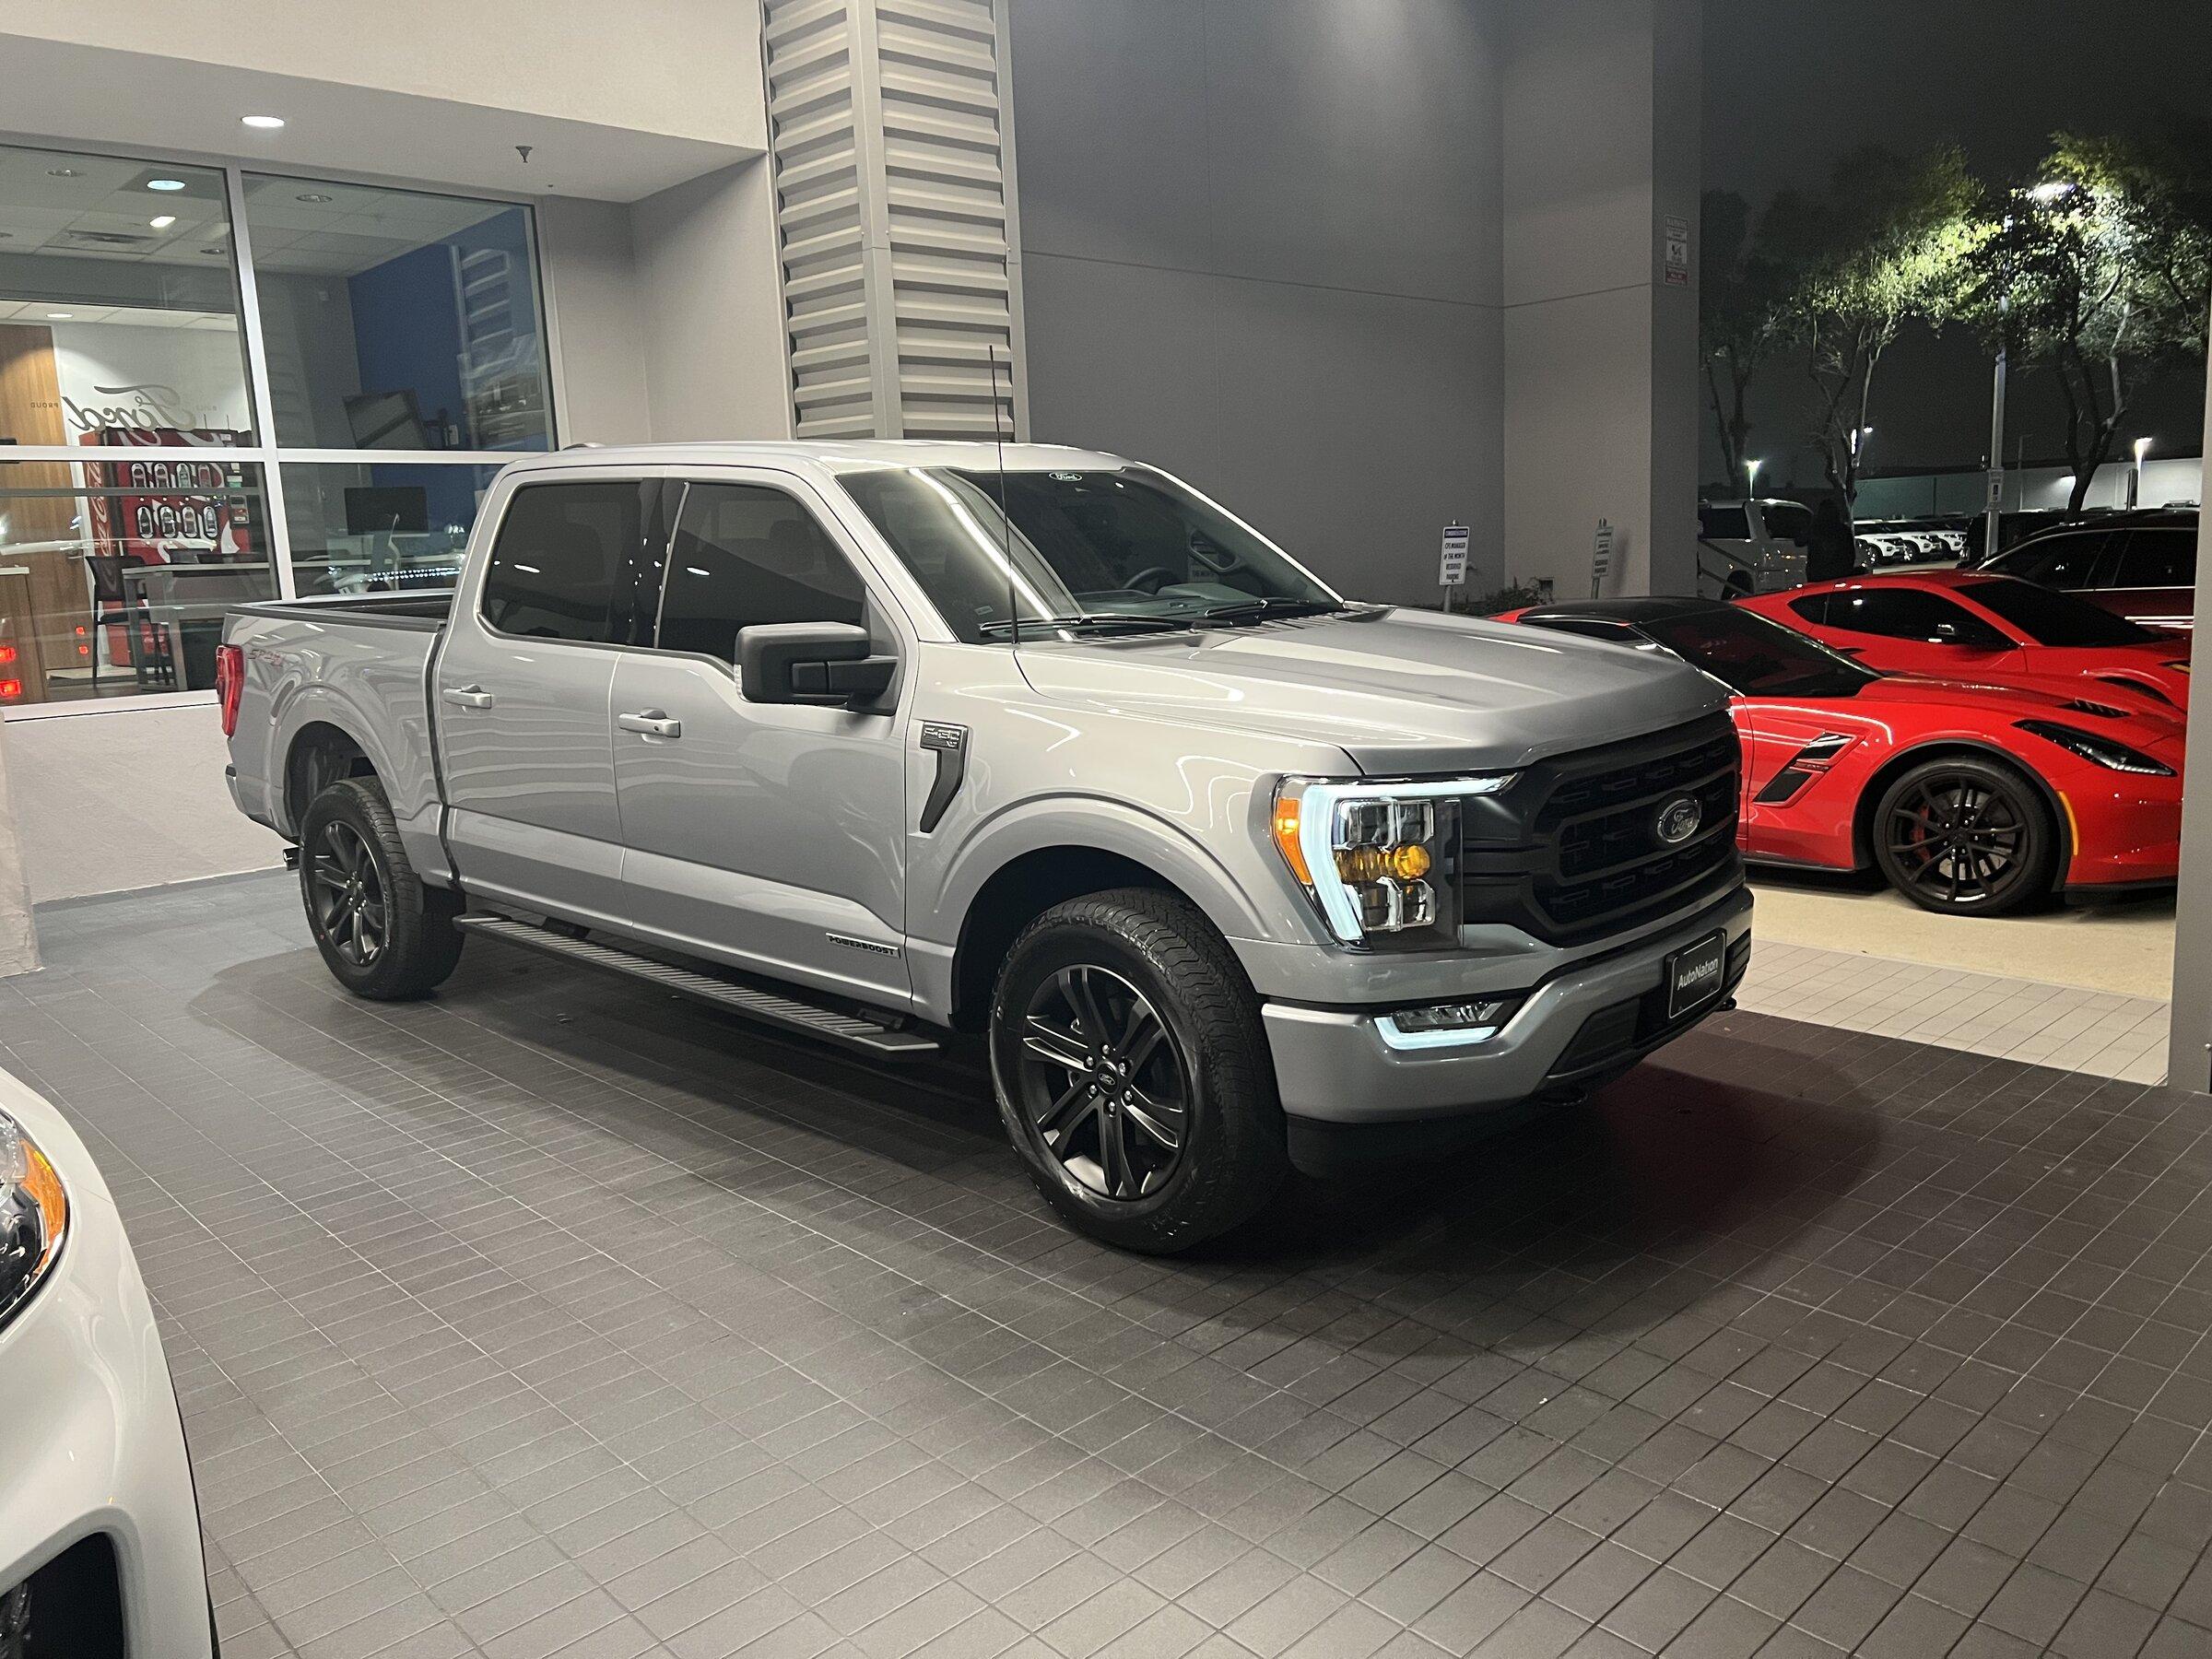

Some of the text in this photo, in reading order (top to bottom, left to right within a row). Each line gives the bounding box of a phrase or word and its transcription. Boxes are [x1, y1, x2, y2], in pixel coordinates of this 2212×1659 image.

[1671, 807, 1695, 834] Ford
[828, 935, 896, 956] POWERBOOST
[1677, 957, 1719, 991] AutoNation
